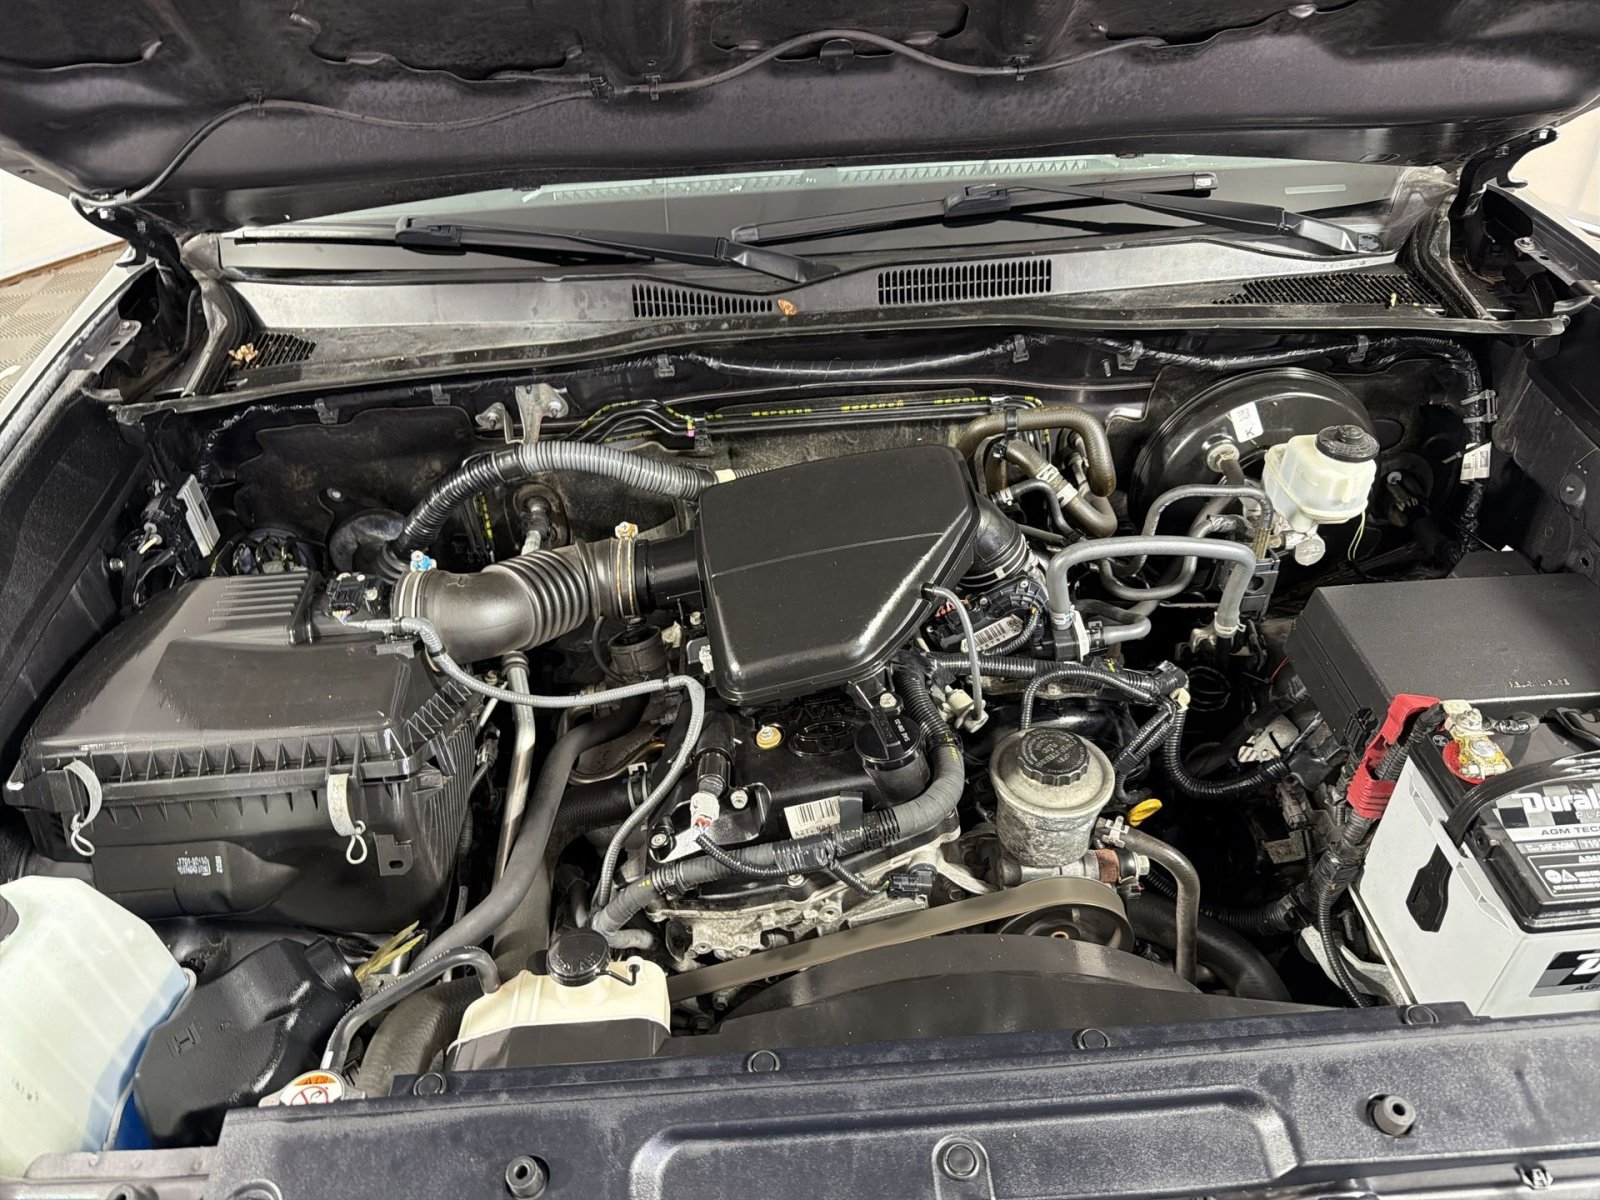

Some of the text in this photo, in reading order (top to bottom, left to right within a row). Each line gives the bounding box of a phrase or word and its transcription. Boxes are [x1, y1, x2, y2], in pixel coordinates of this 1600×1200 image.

[1246, 426, 1255, 437] K
[1510, 788, 1600, 813] Dural
[1541, 825, 1600, 836] AGM TEC
